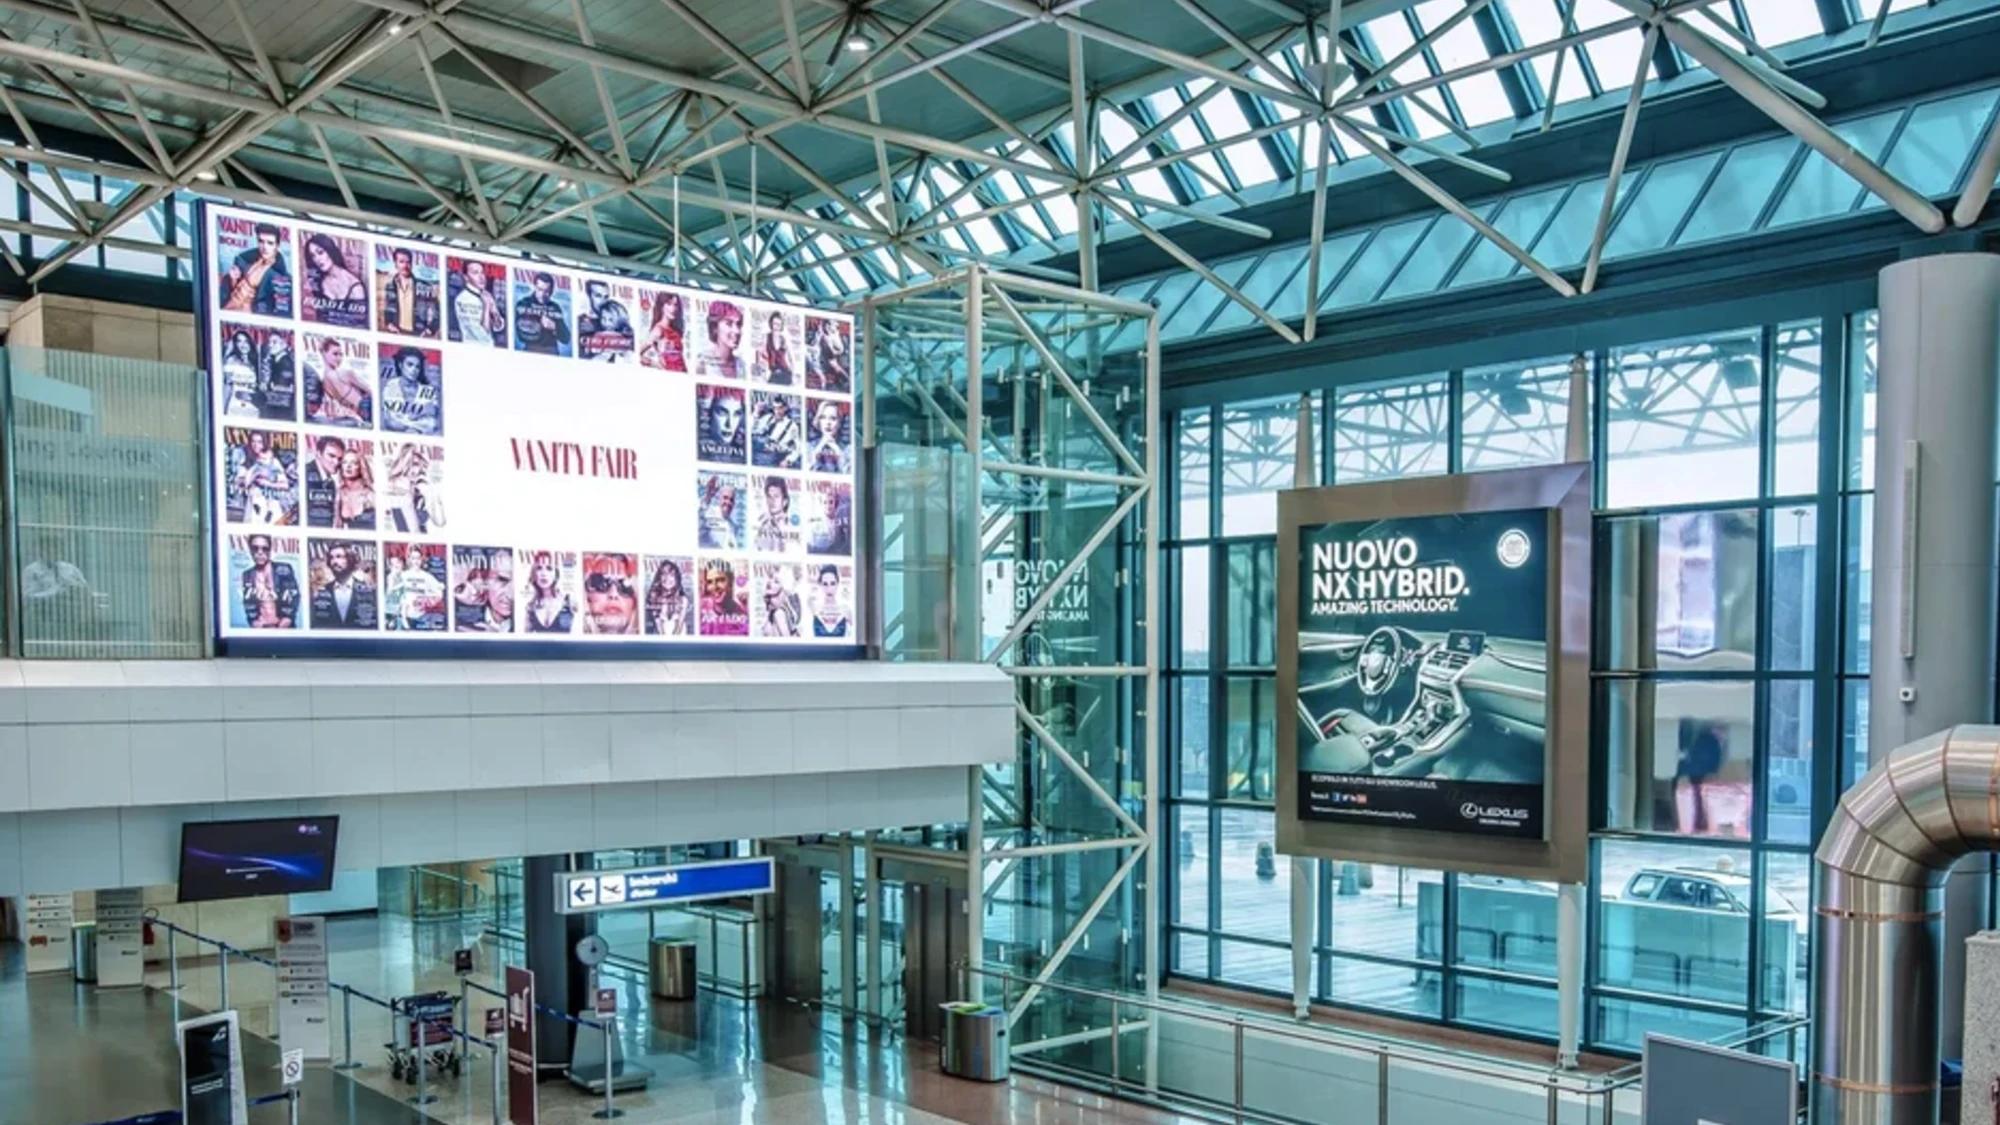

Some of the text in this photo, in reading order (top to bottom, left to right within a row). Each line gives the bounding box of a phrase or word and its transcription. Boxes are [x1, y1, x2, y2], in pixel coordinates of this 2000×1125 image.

[509, 437, 638, 480] VANITY FAIR
[1312, 538, 1418, 571] NUOVO
[1312, 566, 1471, 600] NX HYBRID.
[1311, 598, 1458, 615] AMAZING TECHNOLOGY.
[1478, 806, 1530, 820] LEXUS
